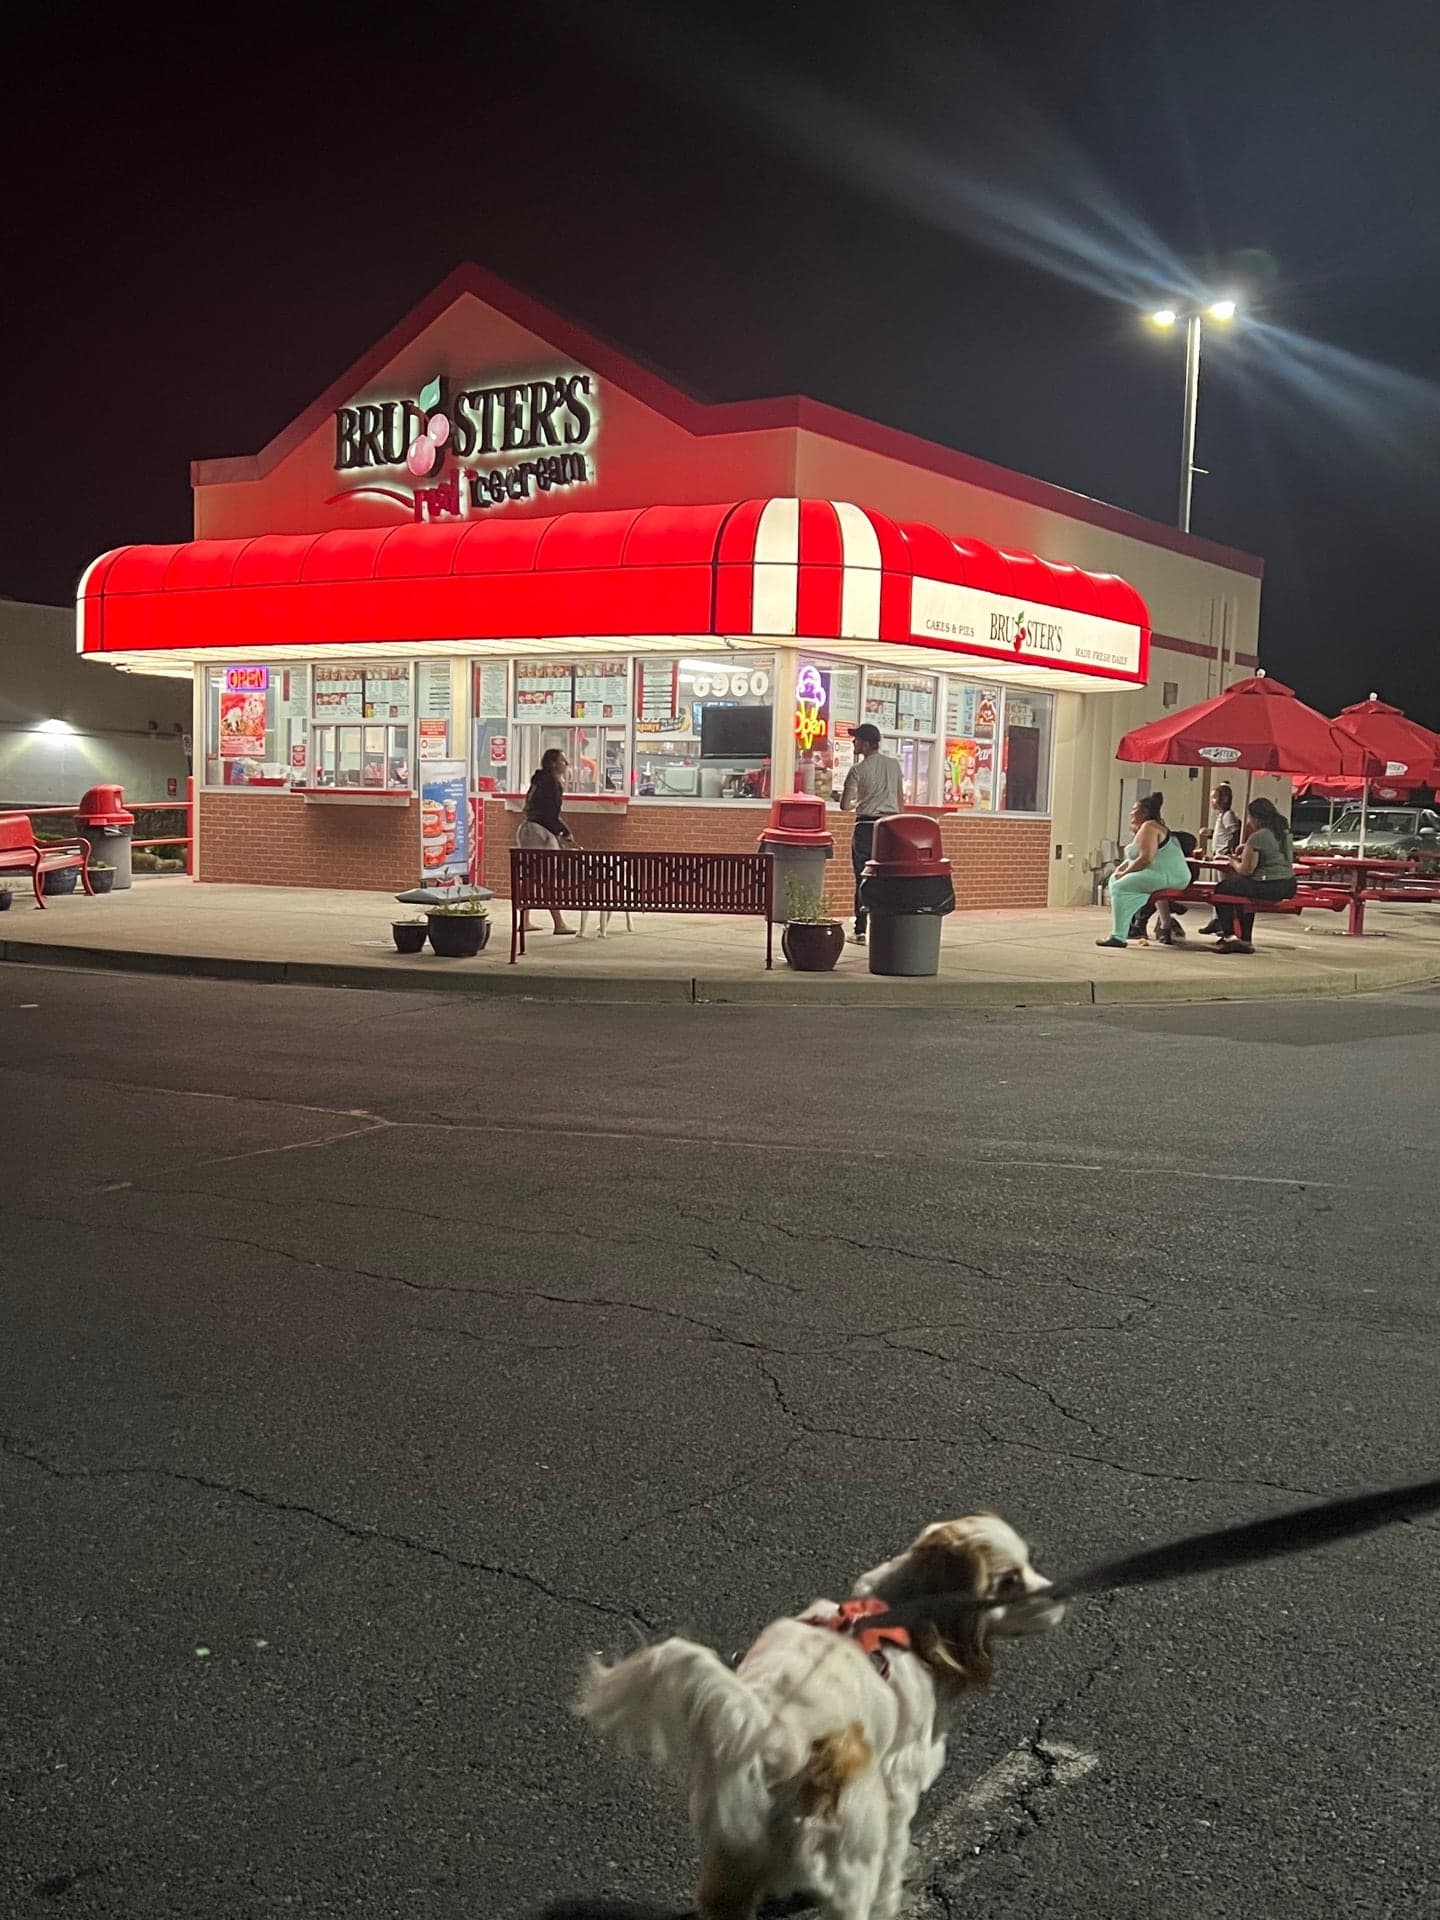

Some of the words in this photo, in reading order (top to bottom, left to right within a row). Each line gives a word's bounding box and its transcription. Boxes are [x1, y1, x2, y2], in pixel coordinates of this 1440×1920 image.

[334, 375, 591, 475] BRUSTER'S
[926, 618, 951, 633] CAKES
[952, 624, 959, 635] &
[959, 625, 976, 638] PIES
[989, 611, 1064, 653] BRUSTER'S
[1075, 647, 1092, 660] MADE
[1093, 650, 1111, 663] FRESH
[228, 668, 265, 689] OPEN
[692, 671, 769, 698] 6960
[793, 711, 827, 738] Open
